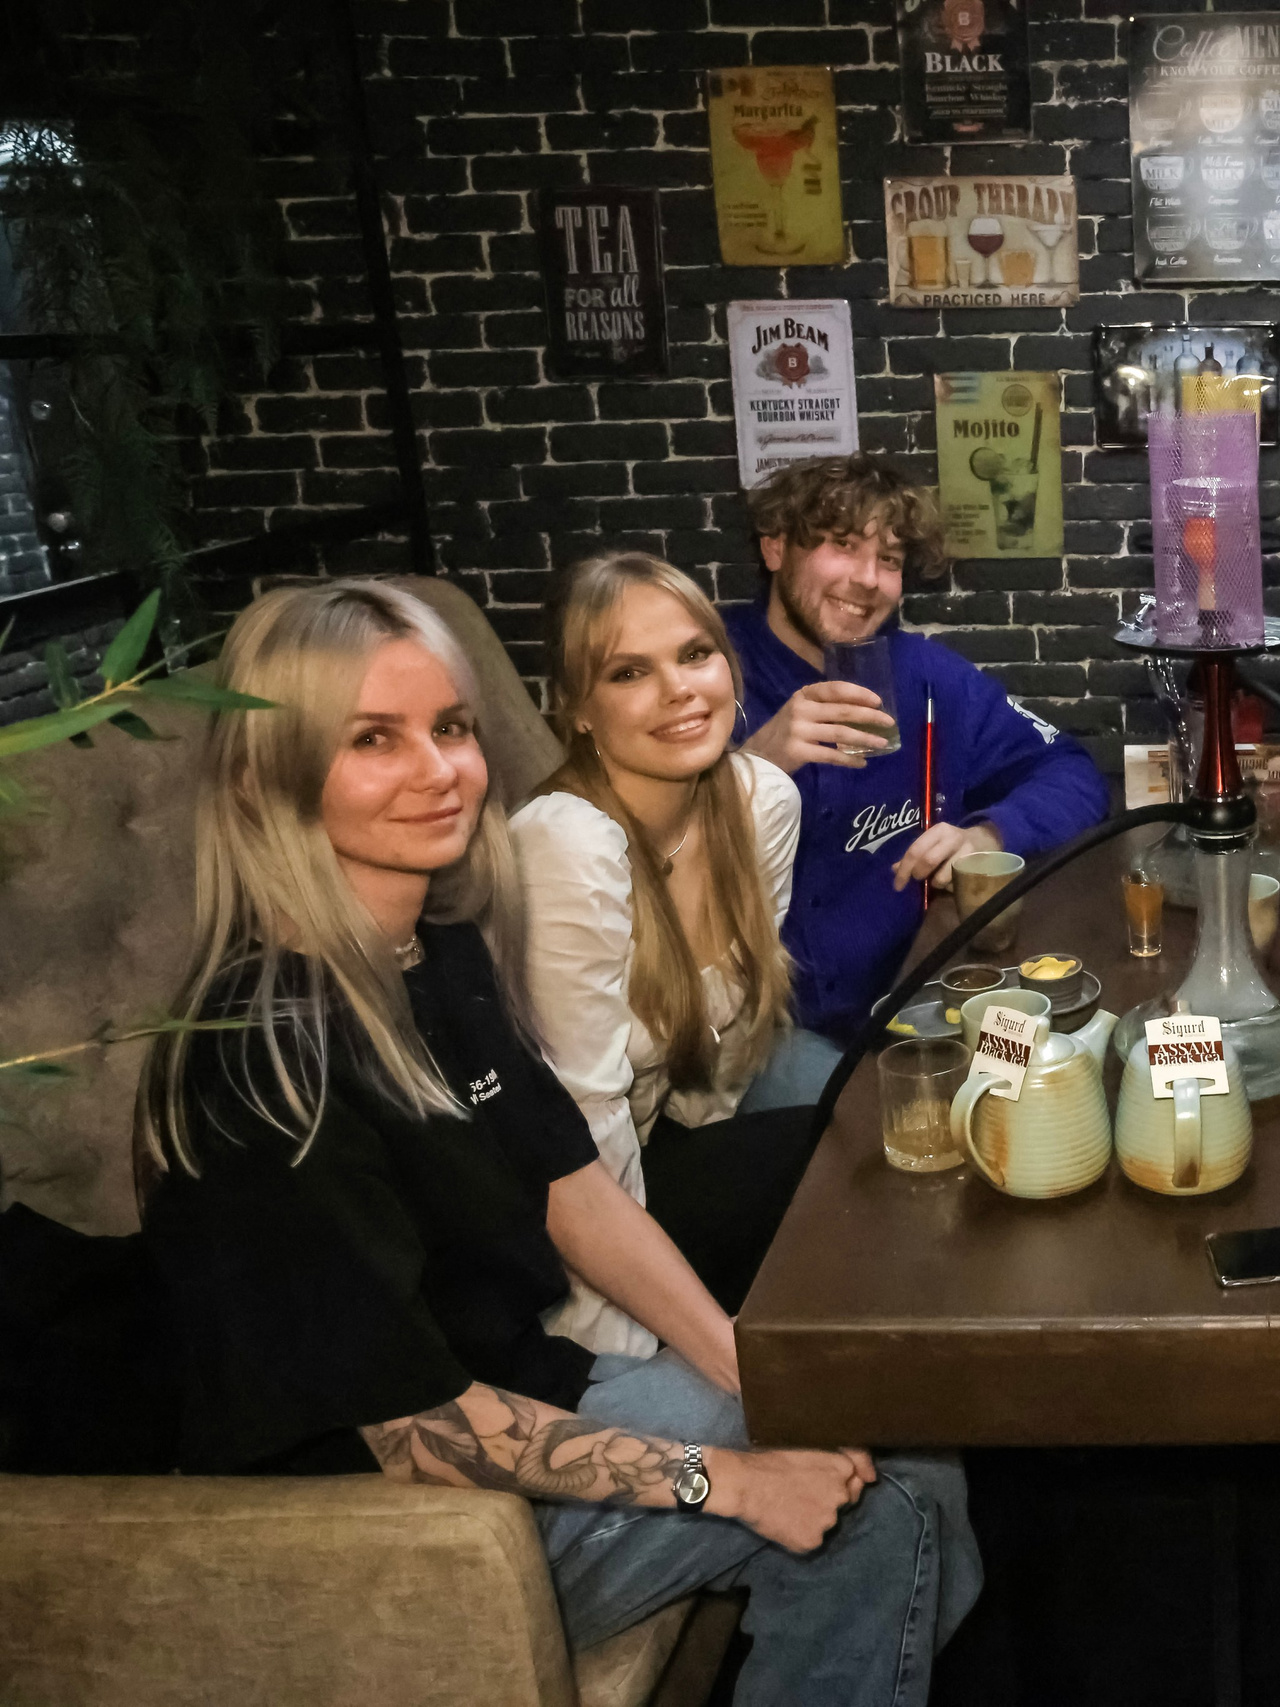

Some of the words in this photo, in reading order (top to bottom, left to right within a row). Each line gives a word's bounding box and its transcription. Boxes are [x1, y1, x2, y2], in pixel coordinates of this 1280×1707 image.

[925, 52, 1004, 73] BLACK
[1160, 65, 1197, 77] KNOW
[1202, 65, 1236, 76] YOUR
[891, 184, 960, 232] GROUP
[974, 183, 1075, 225] THERAPY
[555, 205, 639, 274] TEA
[564, 288, 607, 308] FOR
[610, 274, 642, 308] all
[923, 293, 1001, 307] PRACTICED
[1011, 293, 1046, 306] HERE
[565, 311, 645, 341] REASONS
[752, 323, 781, 354] JIM
[783, 317, 830, 352] BEAM
[750, 399, 796, 412] KENTUCKY
[798, 397, 841, 410] STRAIGHT
[757, 411, 796, 423] BOURBON
[799, 410, 835, 422] WHISKEY
[953, 419, 1020, 440] Mojito
[994, 1011, 1027, 1032] Sigurd
[1162, 1020, 1205, 1038] Sigurd
[985, 1033, 1027, 1058] ASSAM
[1157, 1041, 1217, 1057] ASSAM
[1154, 1052, 1195, 1066] Black
